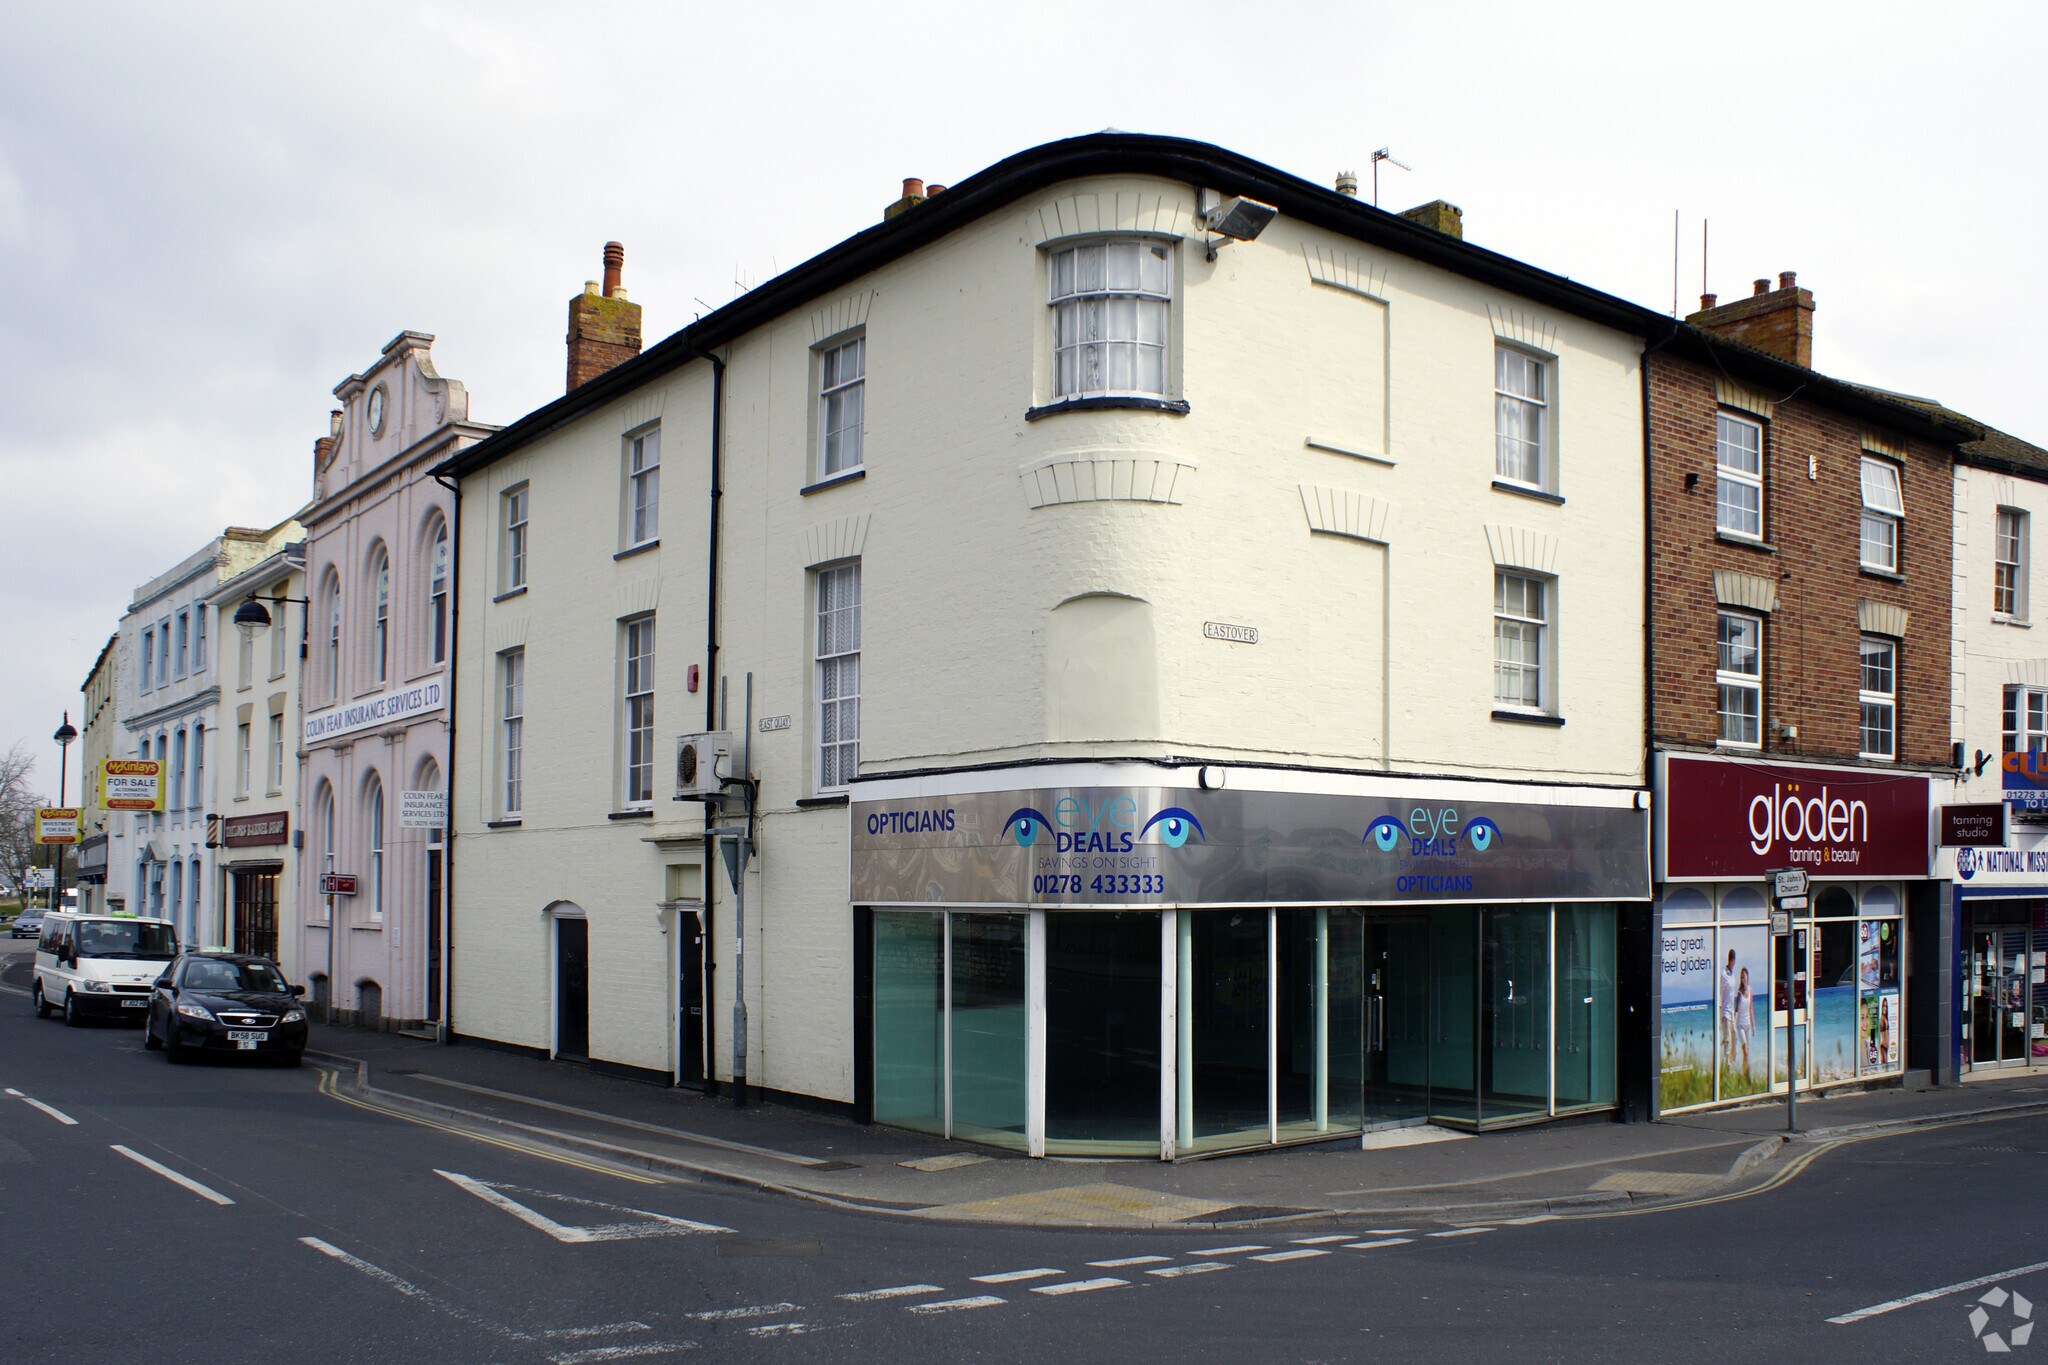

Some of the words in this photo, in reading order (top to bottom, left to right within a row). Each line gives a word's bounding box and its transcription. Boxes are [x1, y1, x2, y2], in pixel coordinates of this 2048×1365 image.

[1207, 624, 1255, 641] EASTOVER
[305, 718, 325, 738] COLIN
[326, 712, 342, 732] FEAR
[344, 699, 385, 727] INSURANCE
[387, 688, 422, 716] SERVICES
[424, 684, 440, 705] LTD
[760, 719, 773, 730] EAST
[107, 778, 128, 786] FOR
[130, 778, 156, 787] SALE
[427, 792, 443, 800] FEAR
[2006, 791, 2035, 799] 01278
[2024, 800, 2038, 808] TO
[867, 809, 955, 835] OPTICIANS
[1055, 796, 1137, 840] eye
[1410, 807, 1458, 845] eye
[1748, 783, 1867, 856] glöden
[1953, 814, 1993, 826] tanning
[1957, 827, 1989, 837] studio
[1056, 831, 1134, 853] DEALS
[1411, 838, 1456, 856] DEALS
[1039, 857, 1088, 868] SAVINGS
[1092, 857, 1115, 868] ON
[1120, 857, 1157, 868] SIGHT
[1789, 847, 1821, 866] tanning
[1823, 847, 1830, 862] &
[1831, 848, 1860, 865] beauty
[1986, 851, 2024, 872] NATIONAL
[1034, 875, 1082, 894] 01278
[1090, 875, 1164, 894] 433333
[1396, 875, 1472, 892] OPTICIANS
[1662, 938, 1678, 951] feel
[1680, 936, 1706, 954] great,
[1662, 959, 1678, 973] feel
[1680, 957, 1711, 975] glöden
